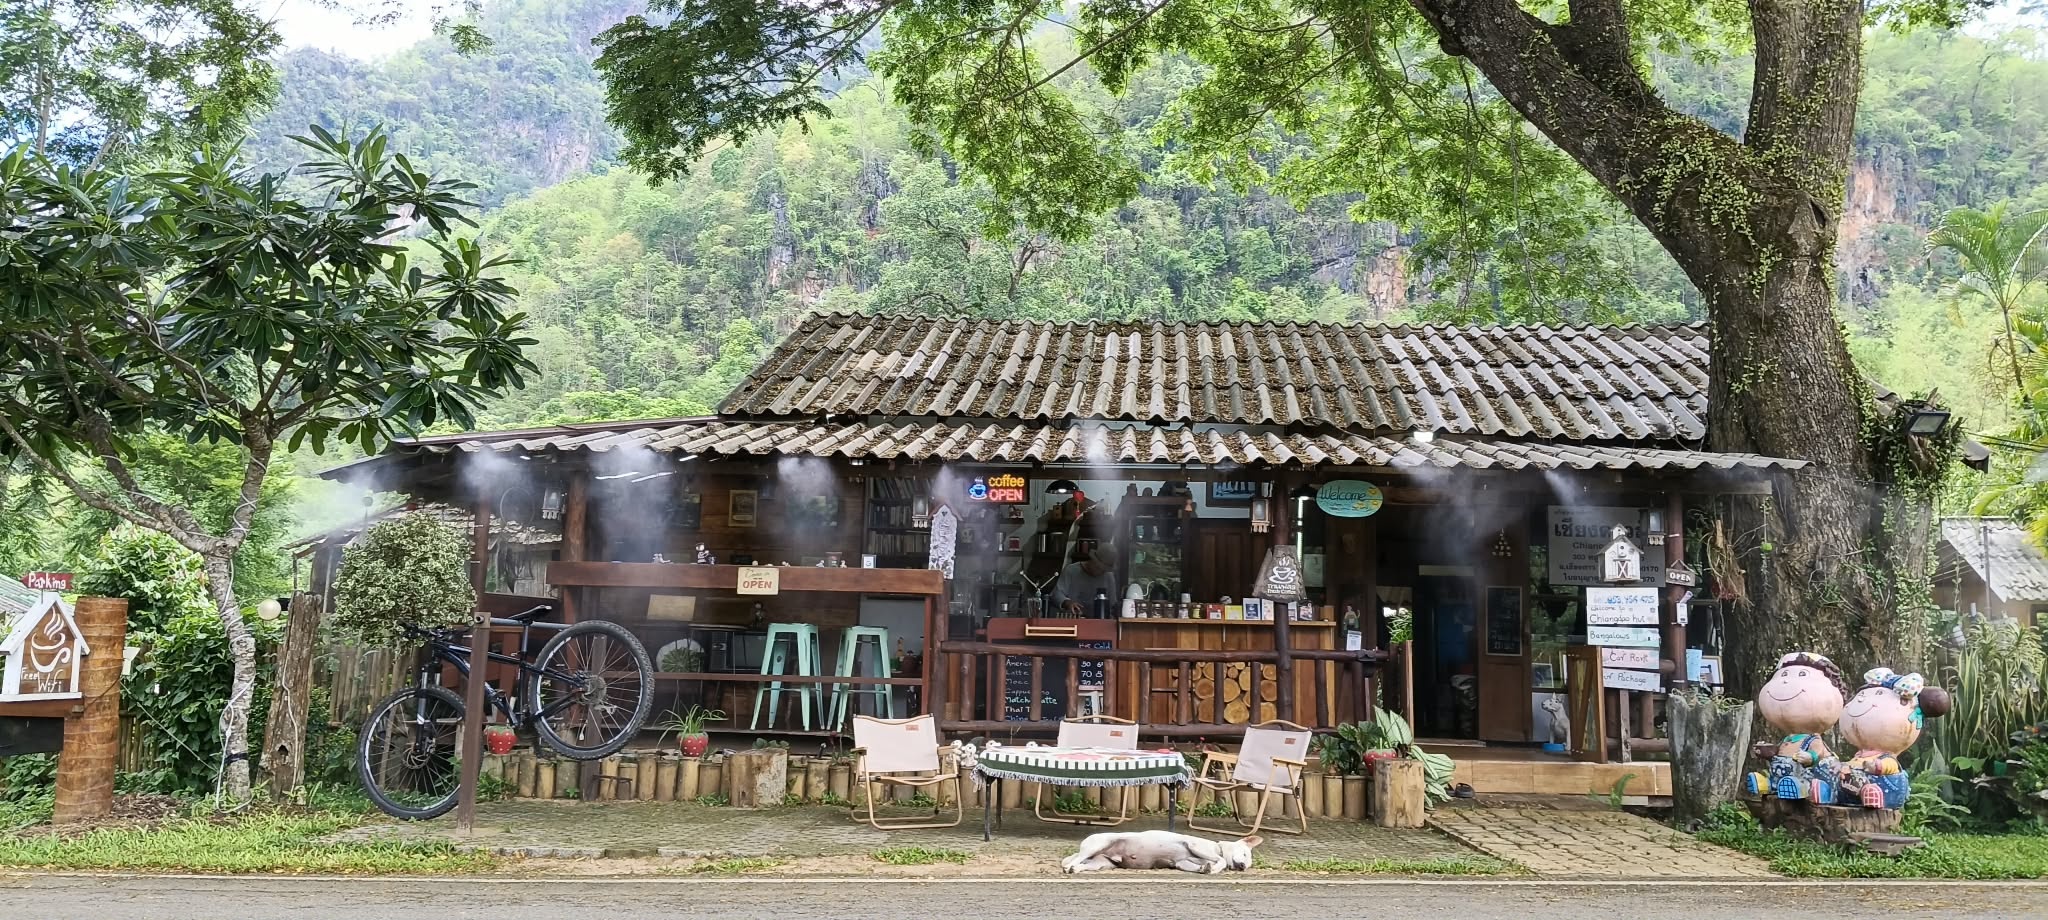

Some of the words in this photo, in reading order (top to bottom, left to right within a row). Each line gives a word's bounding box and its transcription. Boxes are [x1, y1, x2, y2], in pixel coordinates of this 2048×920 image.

[989, 474, 1025, 487] coffee
[989, 489, 1023, 501] OPEN
[1320, 486, 1367, 501] Welcome
[28, 572, 66, 589] Parking
[1670, 572, 1691, 582] OPEN
[742, 580, 772, 589] OPEN
[21, 667, 38, 680] Free
[1040, 697, 1058, 705] atte
